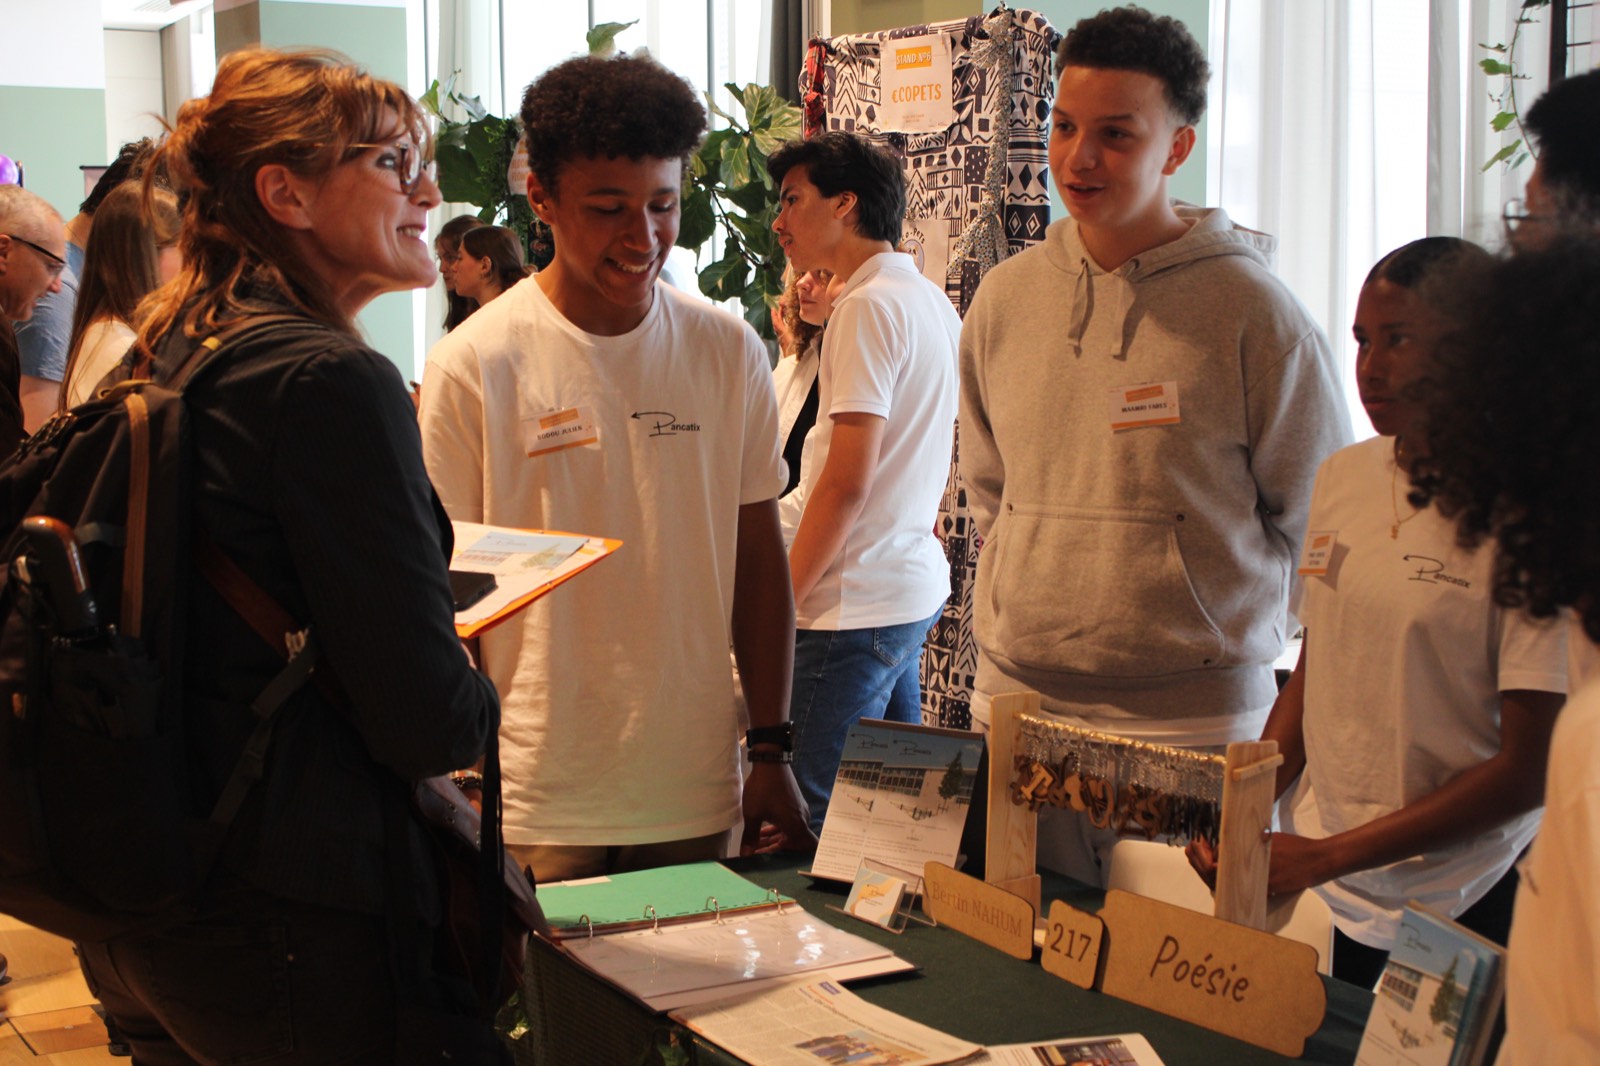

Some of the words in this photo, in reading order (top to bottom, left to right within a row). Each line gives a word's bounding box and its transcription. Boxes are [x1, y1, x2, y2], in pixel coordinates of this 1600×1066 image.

[896, 53, 916, 65] STAND
[631, 411, 701, 438] Pancatix
[1403, 554, 1471, 588] Pancatix
[931, 881, 969, 914] Bertin
[972, 901, 1023, 937] NAHUM
[1050, 923, 1092, 963] 217
[1150, 935, 1249, 1002] Poésie
